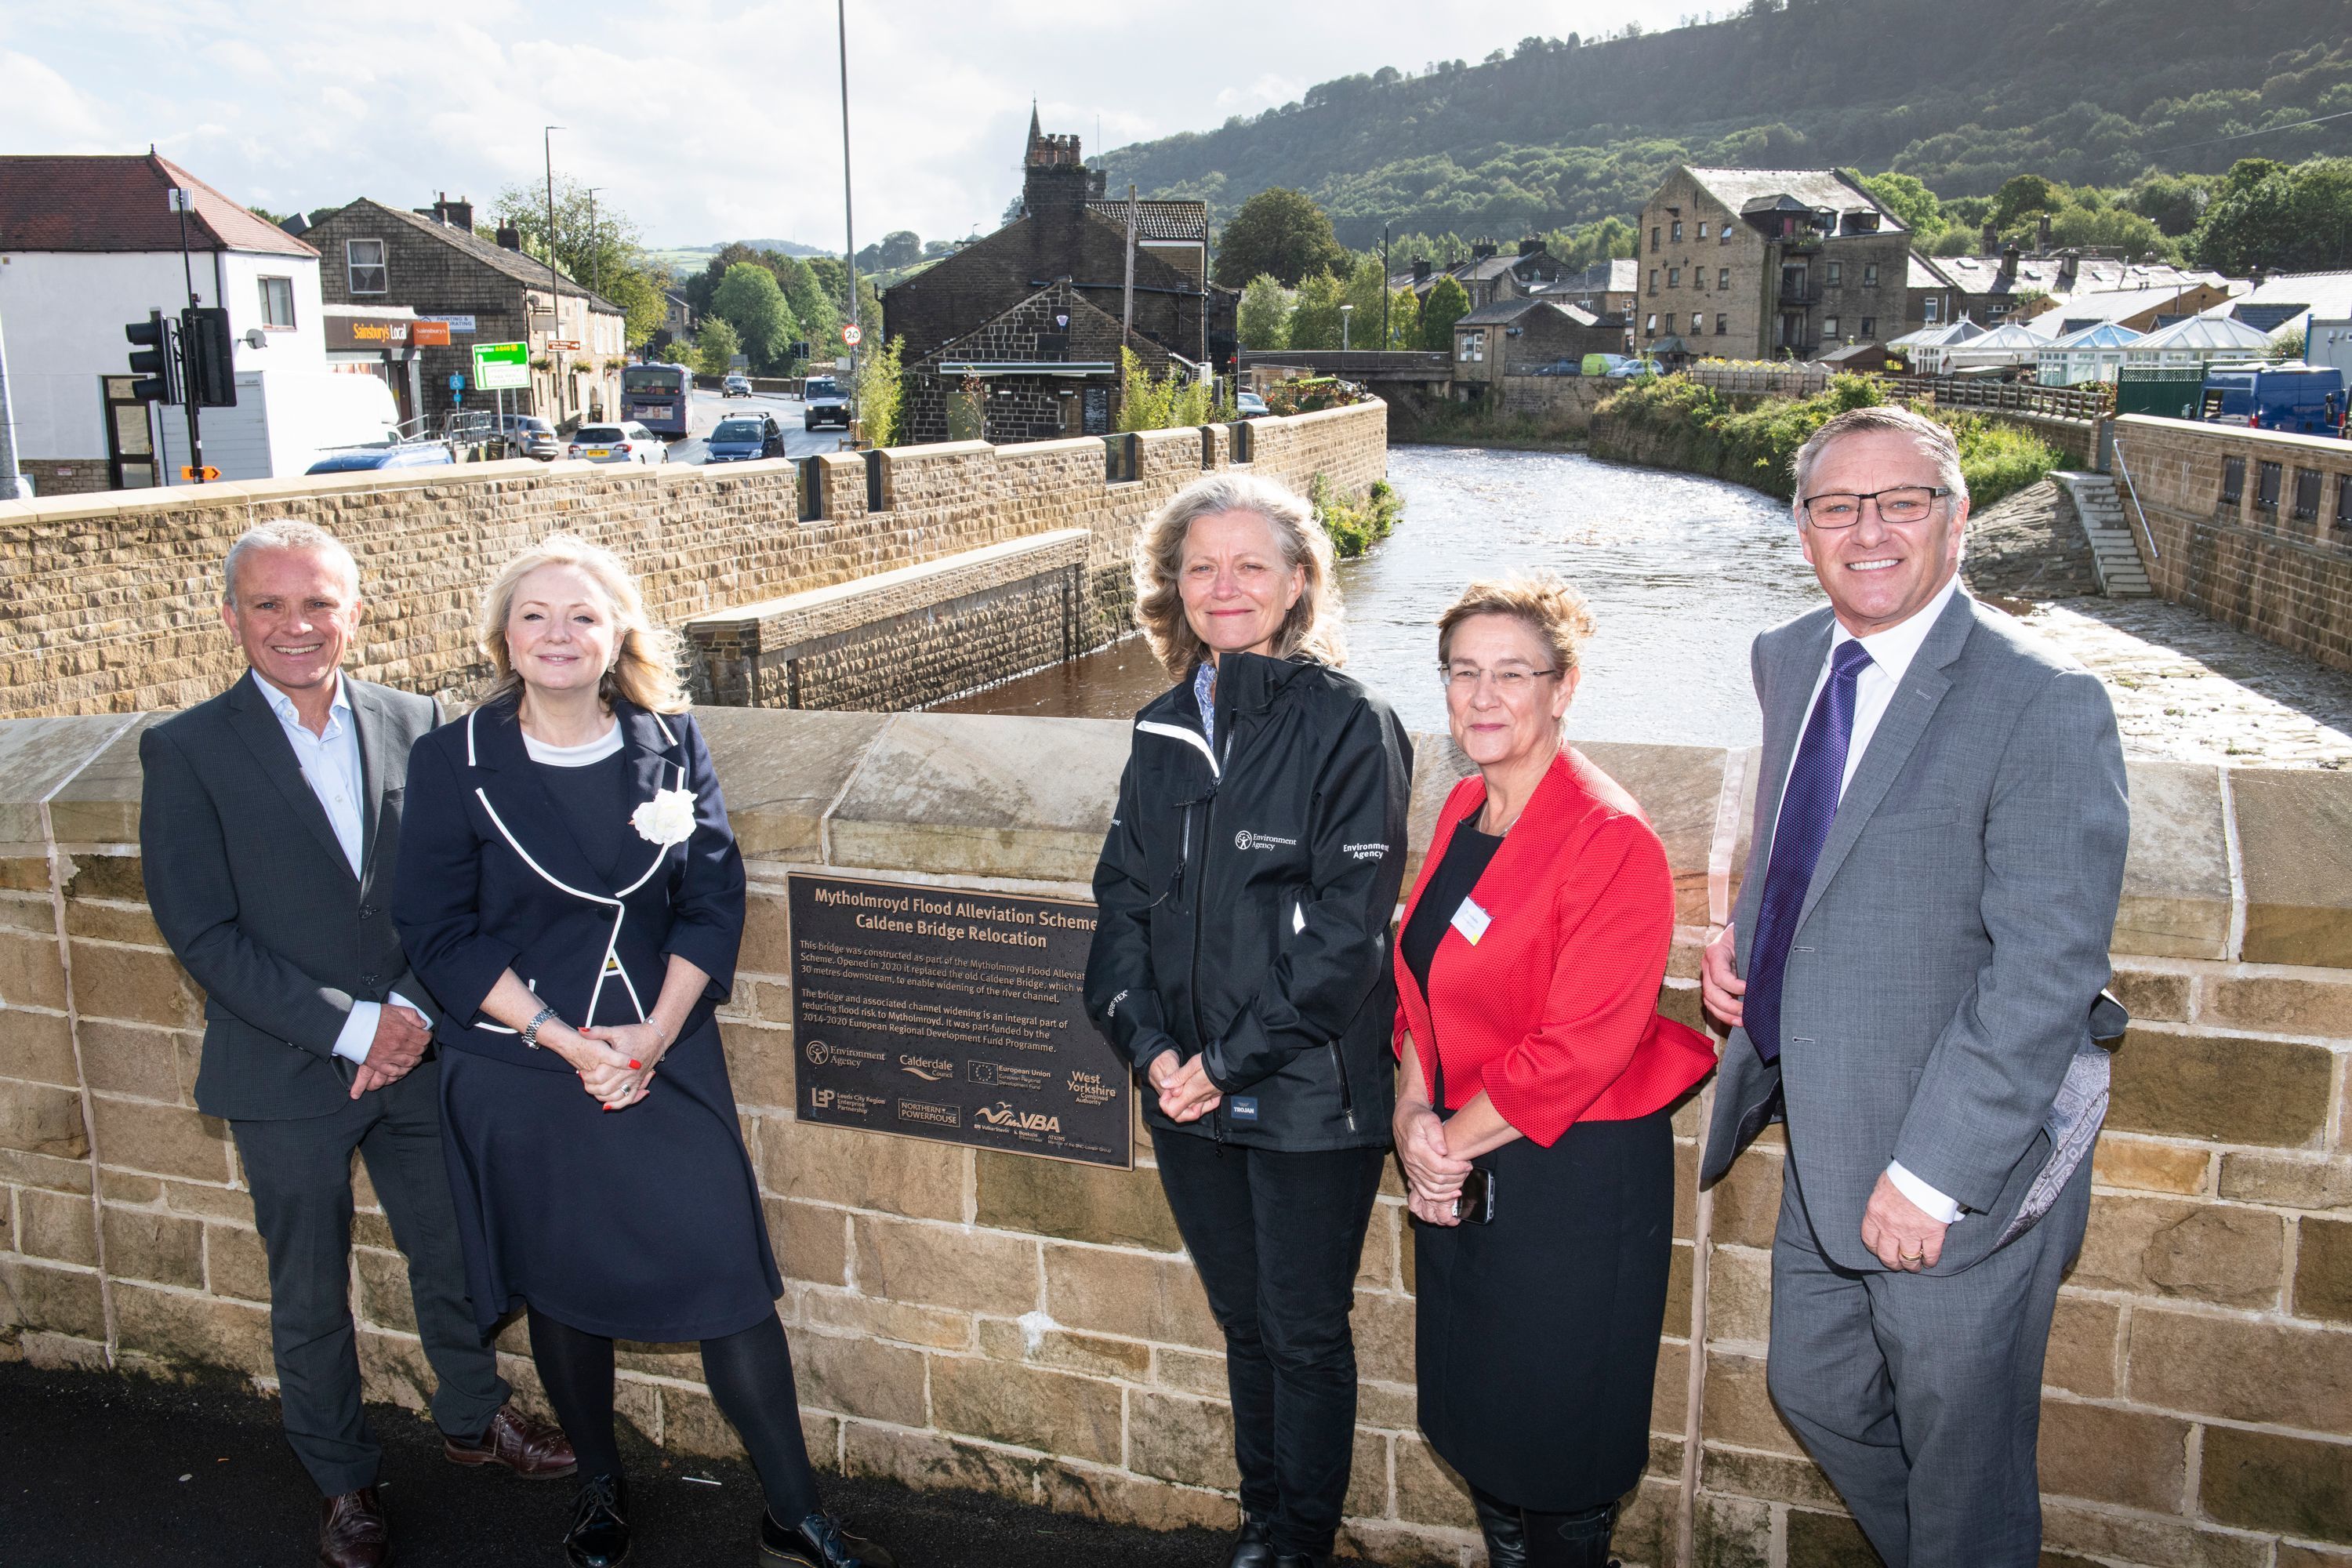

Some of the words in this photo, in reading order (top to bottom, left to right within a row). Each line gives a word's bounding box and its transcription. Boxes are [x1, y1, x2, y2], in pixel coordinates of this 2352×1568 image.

[354, 323, 390, 343] Sainsbury's
[390, 323, 406, 339] Local
[1252, 840, 1276, 851] Agency
[1253, 833, 1297, 845] Environment
[1343, 843, 1389, 852] Environment
[1352, 851, 1384, 859] Agency
[815, 887, 909, 913] Mytholmroyd
[913, 898, 952, 916] Flood
[955, 902, 1034, 924] Alleviation
[1039, 911, 1098, 931] Scheme
[856, 914, 913, 933] Caldene
[917, 920, 964, 941] Bridge
[968, 926, 1047, 948] Relocation
[800, 940, 816, 950] This
[818, 942, 844, 954] bridge
[846, 946, 862, 955] was
[864, 949, 912, 960] constructed
[925, 955, 942, 964] part
[944, 956, 953, 965] of
[954, 958, 968, 967] the
[970, 960, 1025, 975] Mytholmroyd
[1027, 966, 1051, 977] Flood
[1052, 969, 1085, 981] Alleviat
[800, 953, 835, 964] Scheme.
[837, 956, 869, 968] Opened
[870, 960, 878, 969] in
[880, 962, 902, 971] 2020
[904, 964, 910, 972] it
[912, 966, 947, 977] replaced
[949, 970, 963, 979] the
[964, 971, 978, 981] old
[980, 973, 1014, 985] Caldene
[1048, 982, 1074, 993] which
[800, 965, 811, 974] 30
[813, 967, 841, 977] metres
[843, 970, 895, 984] downstream,
[896, 976, 905, 985] to
[907, 978, 935, 988] enable
[936, 981, 975, 994] widening
[976, 985, 985, 994] of
[986, 986, 1000, 996] the
[1002, 988, 1021, 998] river
[1022, 991, 1060, 1003] channel.
[801, 989, 816, 998] The
[818, 990, 844, 1003] bridge
[845, 995, 861, 1004] and
[862, 997, 906, 1009] associated
[909, 1001, 942, 1013] channel
[943, 1006, 982, 1020] widening
[983, 1011, 990, 1019] is
[1005, 1013, 1037, 1025] integral
[1039, 1019, 1057, 1029] part
[1058, 1021, 1069, 1029] of
[802, 1001, 837, 1014] reducing
[838, 1005, 859, 1015] flood
[861, 1008, 876, 1018] risk
[877, 1011, 886, 1019] to
[888, 1011, 944, 1027] Mytholmroyd.
[953, 1021, 971, 1029] was
[972, 1023, 1022, 1036] part-funded
[1023, 1029, 1034, 1039] by
[1036, 1029, 1050, 1039] the
[803, 1013, 847, 1026] 2014-2020
[849, 1018, 887, 1031] European
[889, 1024, 924, 1036] Regional
[926, 1028, 981, 1043] Development
[982, 1036, 1004, 1046] Fund
[1005, 1038, 1057, 1053] Programme.
[830, 1045, 886, 1061] Environment
[829, 1055, 862, 1069] Agency
[899, 1054, 953, 1071] Calderdale
[931, 1069, 953, 1079] Council
[998, 1065, 1029, 1075] European
[1031, 1069, 1051, 1078] Union
[1071, 1070, 1101, 1084] West
[999, 1080, 1028, 1088] Development
[1067, 1080, 1116, 1097] Yorkshire
[837, 1098, 865, 1108] Enterprise
[866, 1096, 885, 1105] Region
[1076, 1098, 1102, 1106] Authority
[1080, 1092, 1109, 1102] Combined
[837, 1104, 868, 1114] Partnership
[901, 1102, 941, 1113] NORTHERN
[902, 1109, 956, 1123] POWERHOUSE
[1019, 1112, 1061, 1133] VBA
